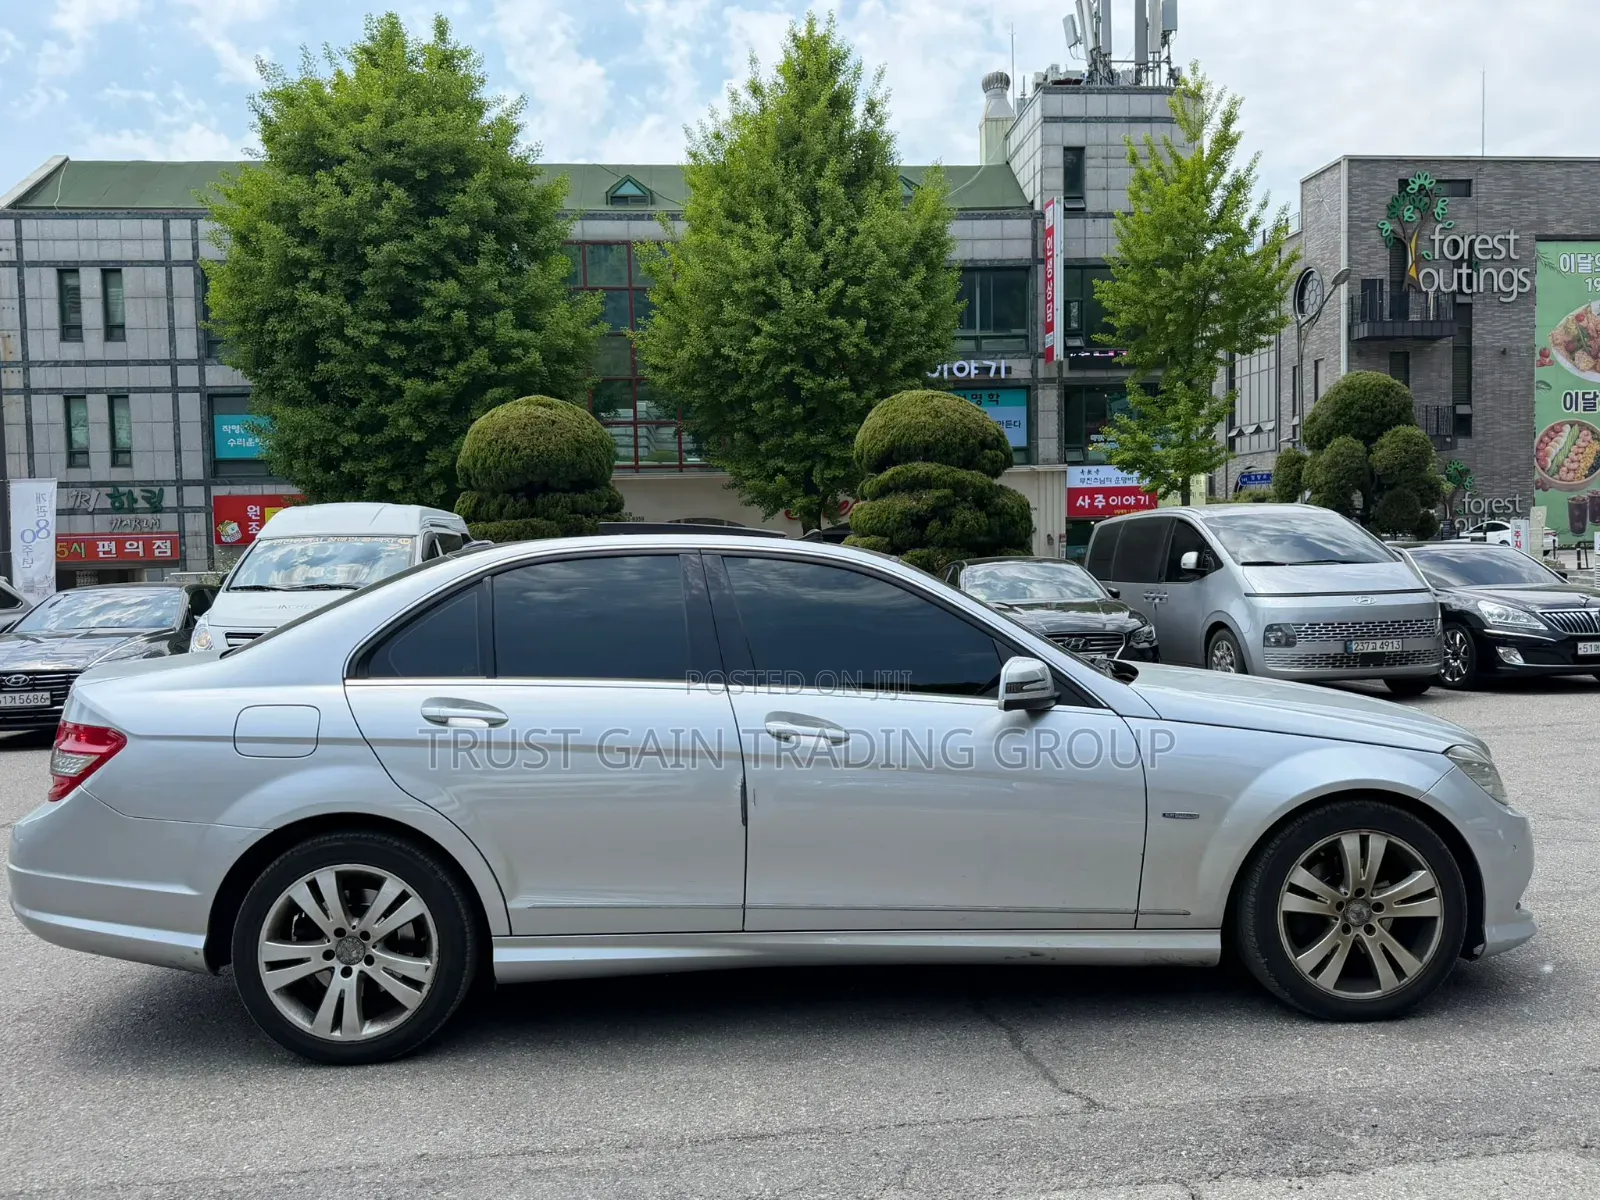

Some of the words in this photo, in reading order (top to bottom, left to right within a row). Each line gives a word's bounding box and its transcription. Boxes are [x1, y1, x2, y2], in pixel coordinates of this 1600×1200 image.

[1430, 223, 1520, 261] forest
[1418, 262, 1532, 303] outings
[957, 393, 1001, 406] 명학
[1076, 494, 1106, 509] 사주
[1109, 495, 1149, 506] 이야기
[1462, 491, 1524, 515] forest
[96, 540, 172, 558] 편의점
